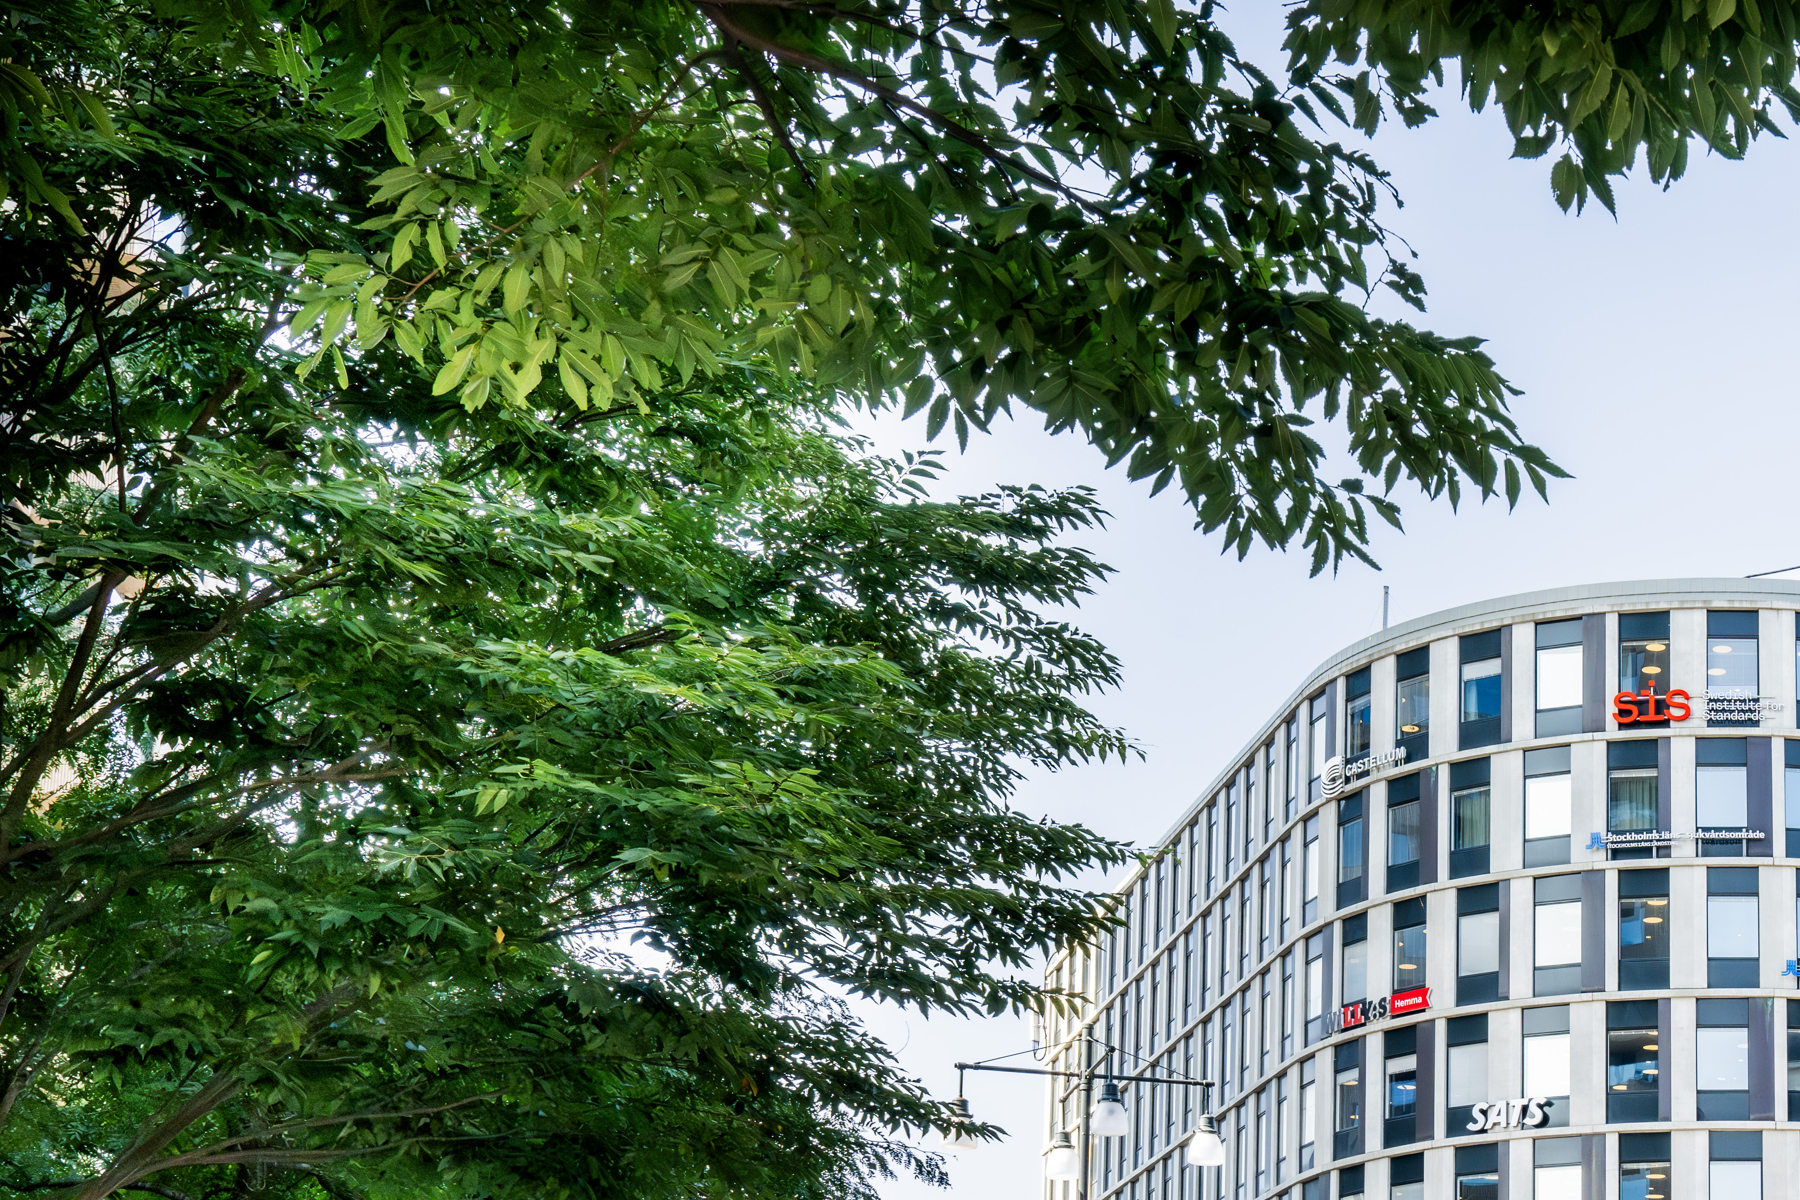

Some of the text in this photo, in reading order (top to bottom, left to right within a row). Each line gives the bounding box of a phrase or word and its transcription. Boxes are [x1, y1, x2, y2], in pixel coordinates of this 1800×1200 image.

[1702, 689, 1752, 701] Swedish
[1704, 700, 1785, 711] Institute for
[1702, 711, 1766, 721] Standards
[1345, 746, 1407, 777] CASTELLUM
[1607, 831, 1660, 842] Stockholms
[1395, 995, 1423, 1008] Hemma
[1466, 1097, 1547, 1131] SATS
